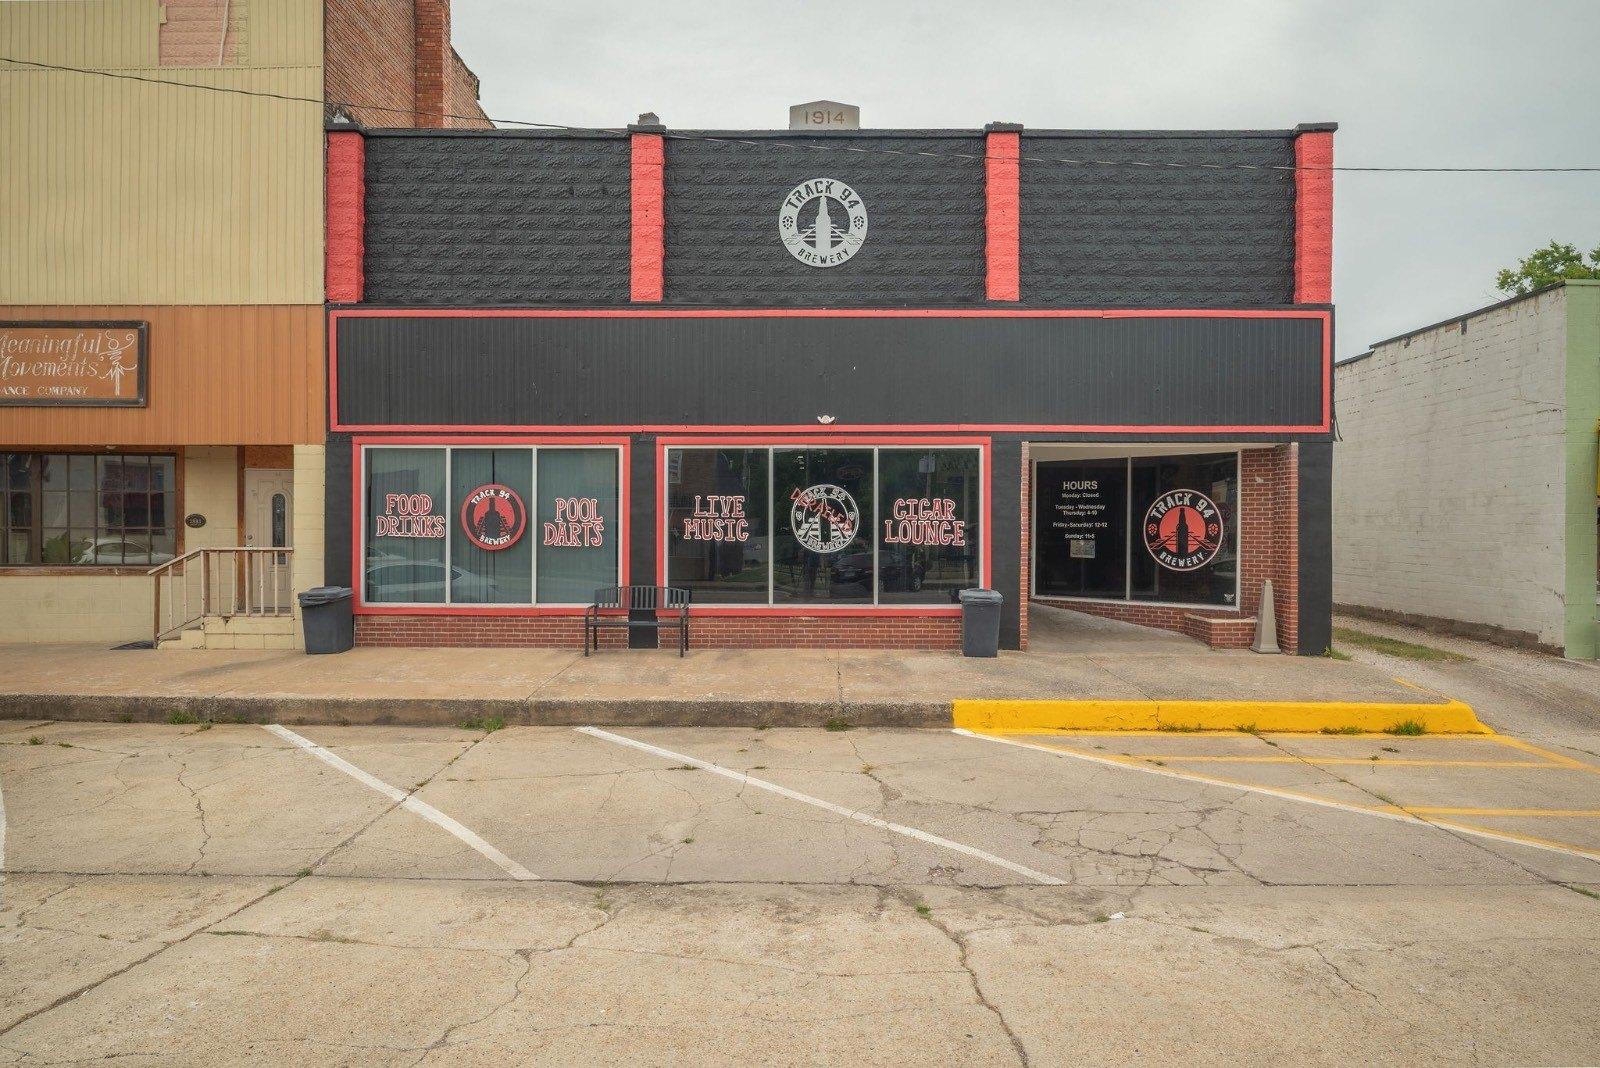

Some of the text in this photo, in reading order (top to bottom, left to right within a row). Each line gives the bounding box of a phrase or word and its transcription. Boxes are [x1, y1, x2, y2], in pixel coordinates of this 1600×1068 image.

[805, 110, 845, 125] 1914
[785, 180, 861, 209] TRACK 94
[797, 248, 850, 264] BREWERY
[0, 386, 88, 396] ANCE COMPANY
[1063, 480, 1098, 490] HOURS
[385, 493, 433, 516] FOOD
[471, 489, 511, 505] TRACK 94
[693, 495, 746, 518] LIVE
[1150, 492, 1215, 519] TRACK 94
[554, 497, 603, 523] POOL
[893, 498, 956, 521] CIGAR
[376, 516, 446, 538] DRINKS
[544, 522, 605, 547] DARTS
[683, 518, 749, 542] MUSIC
[884, 519, 966, 547] LOUNGE
[479, 534, 511, 546] BREWERY
[1159, 551, 1205, 567] BREWERY
